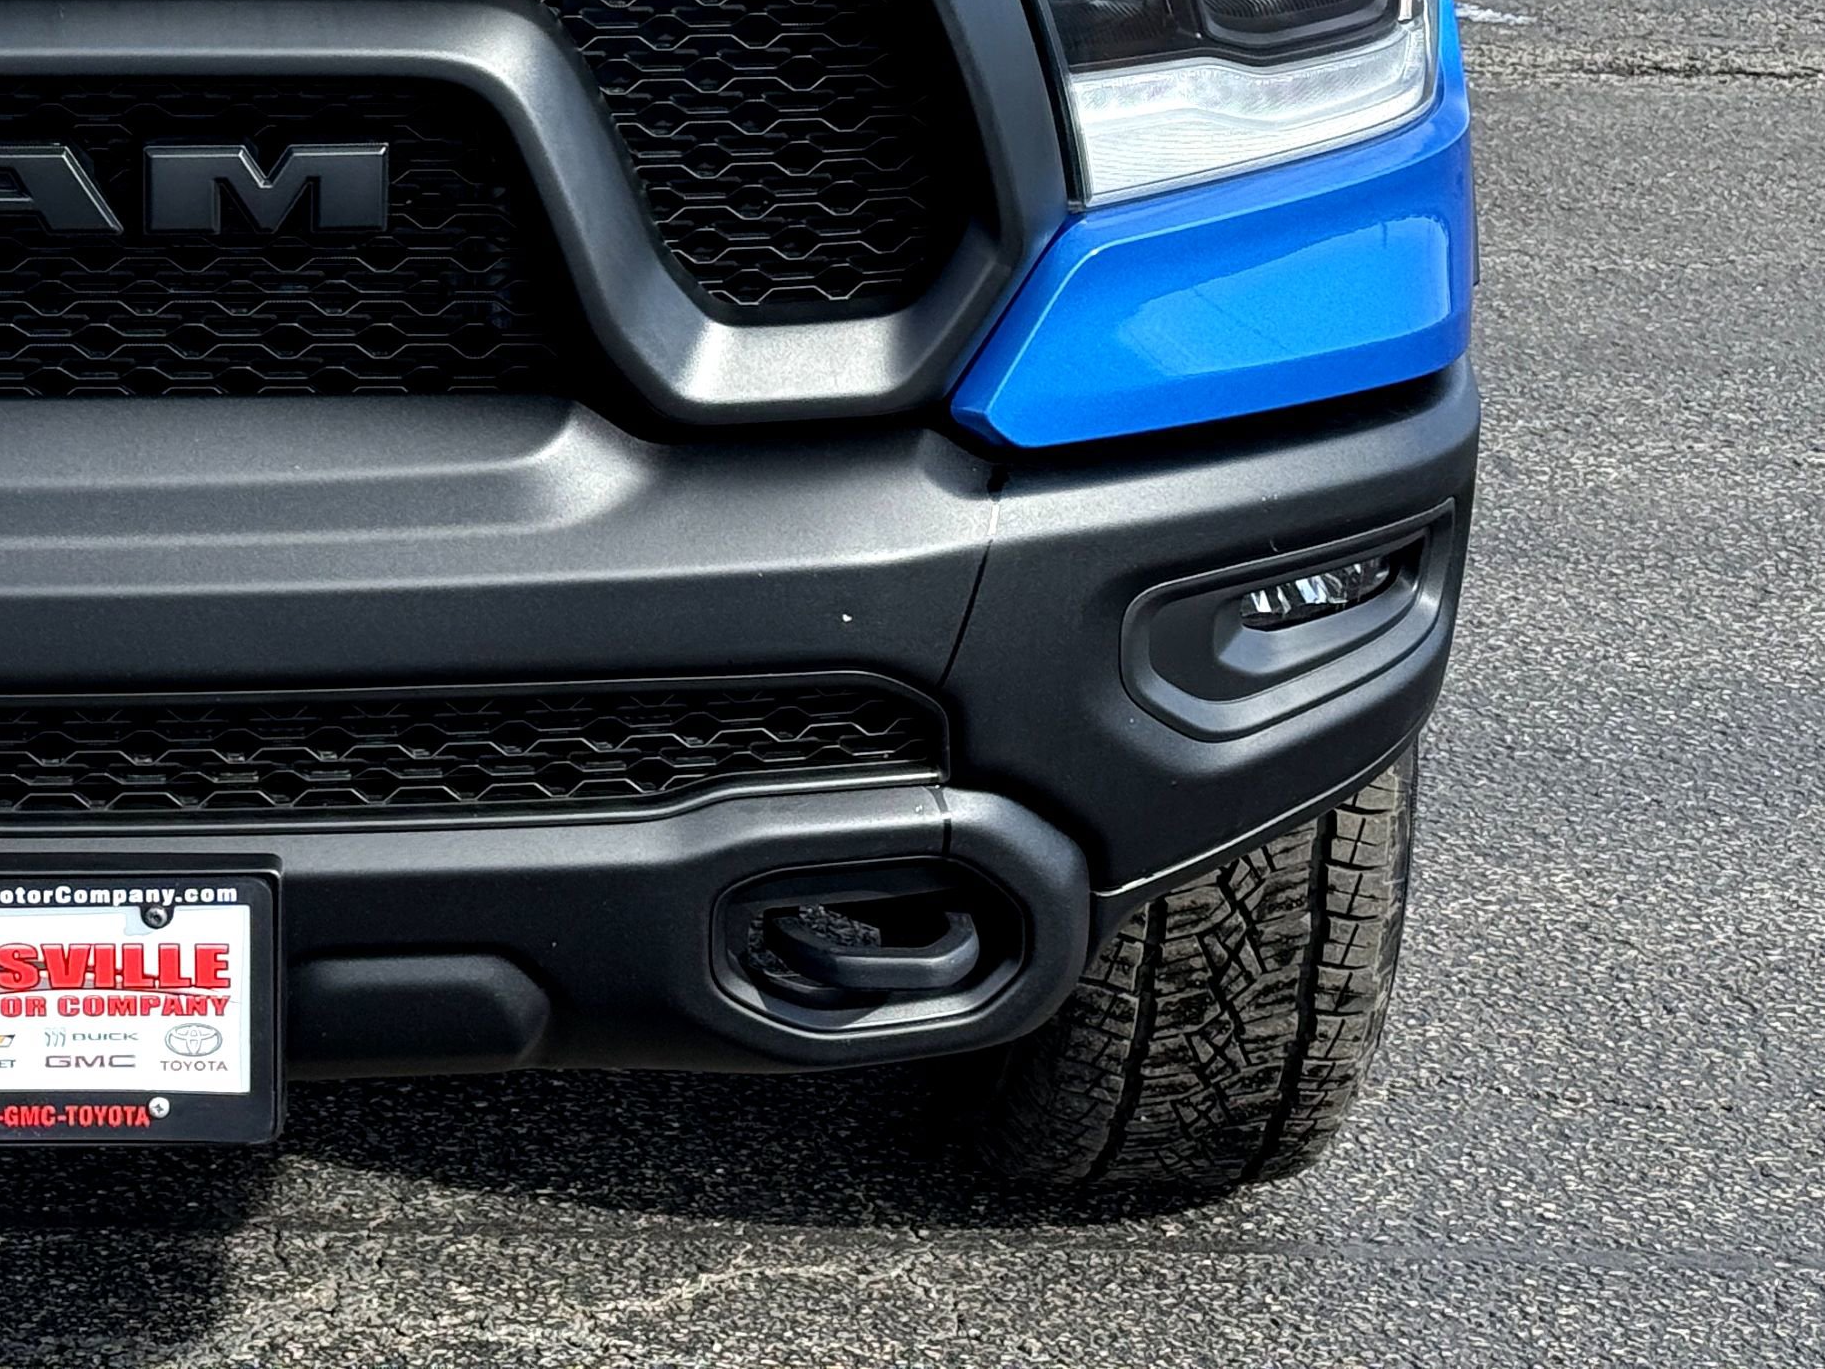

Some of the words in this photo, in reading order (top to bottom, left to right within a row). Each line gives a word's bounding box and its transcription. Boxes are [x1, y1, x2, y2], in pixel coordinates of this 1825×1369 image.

[57, 994, 231, 1018] COMPANY
[44, 1055, 137, 1069] GMC
[159, 1060, 229, 1072] TOYOTA
